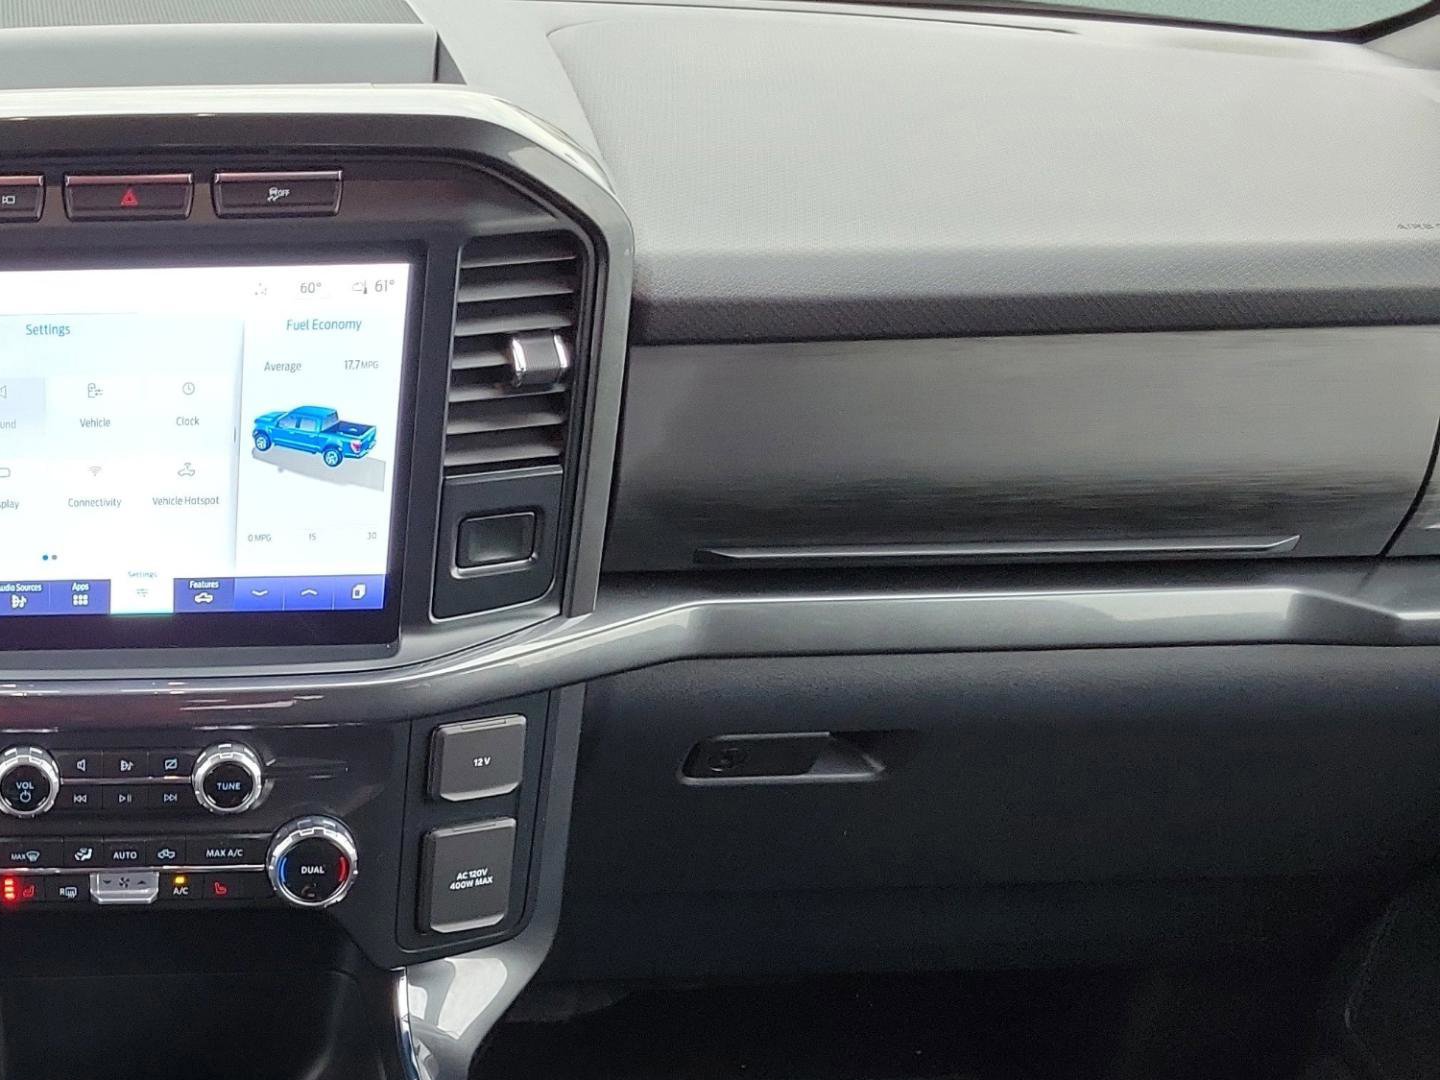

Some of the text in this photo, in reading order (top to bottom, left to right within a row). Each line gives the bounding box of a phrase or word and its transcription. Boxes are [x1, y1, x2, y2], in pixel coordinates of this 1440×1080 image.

[300, 281, 322, 294] 60°
[374, 279, 395, 293] 61°
[25, 323, 71, 337] Settings
[286, 318, 362, 332] Fuel Economy
[264, 361, 302, 374] Average
[80, 417, 111, 428] Vehicle
[176, 416, 200, 427] Clock
[68, 497, 122, 509] Connectivity
[152, 495, 220, 507] Vehicle Hotspot
[255, 533, 272, 542] MPG
[128, 570, 158, 579] Settings
[17, 583, 42, 592] Sources
[72, 581, 89, 593] Apps
[189, 579, 220, 590] Features
[16, 781, 35, 790] VOL
[216, 782, 241, 791] TUNE
[113, 851, 138, 860] AUTO
[205, 849, 244, 858] MAX A/C
[300, 866, 325, 874] DUAL
[456, 867, 489, 881] AC 120V
[449, 875, 494, 890] 400W MAX
[172, 887, 189, 895] A/C
